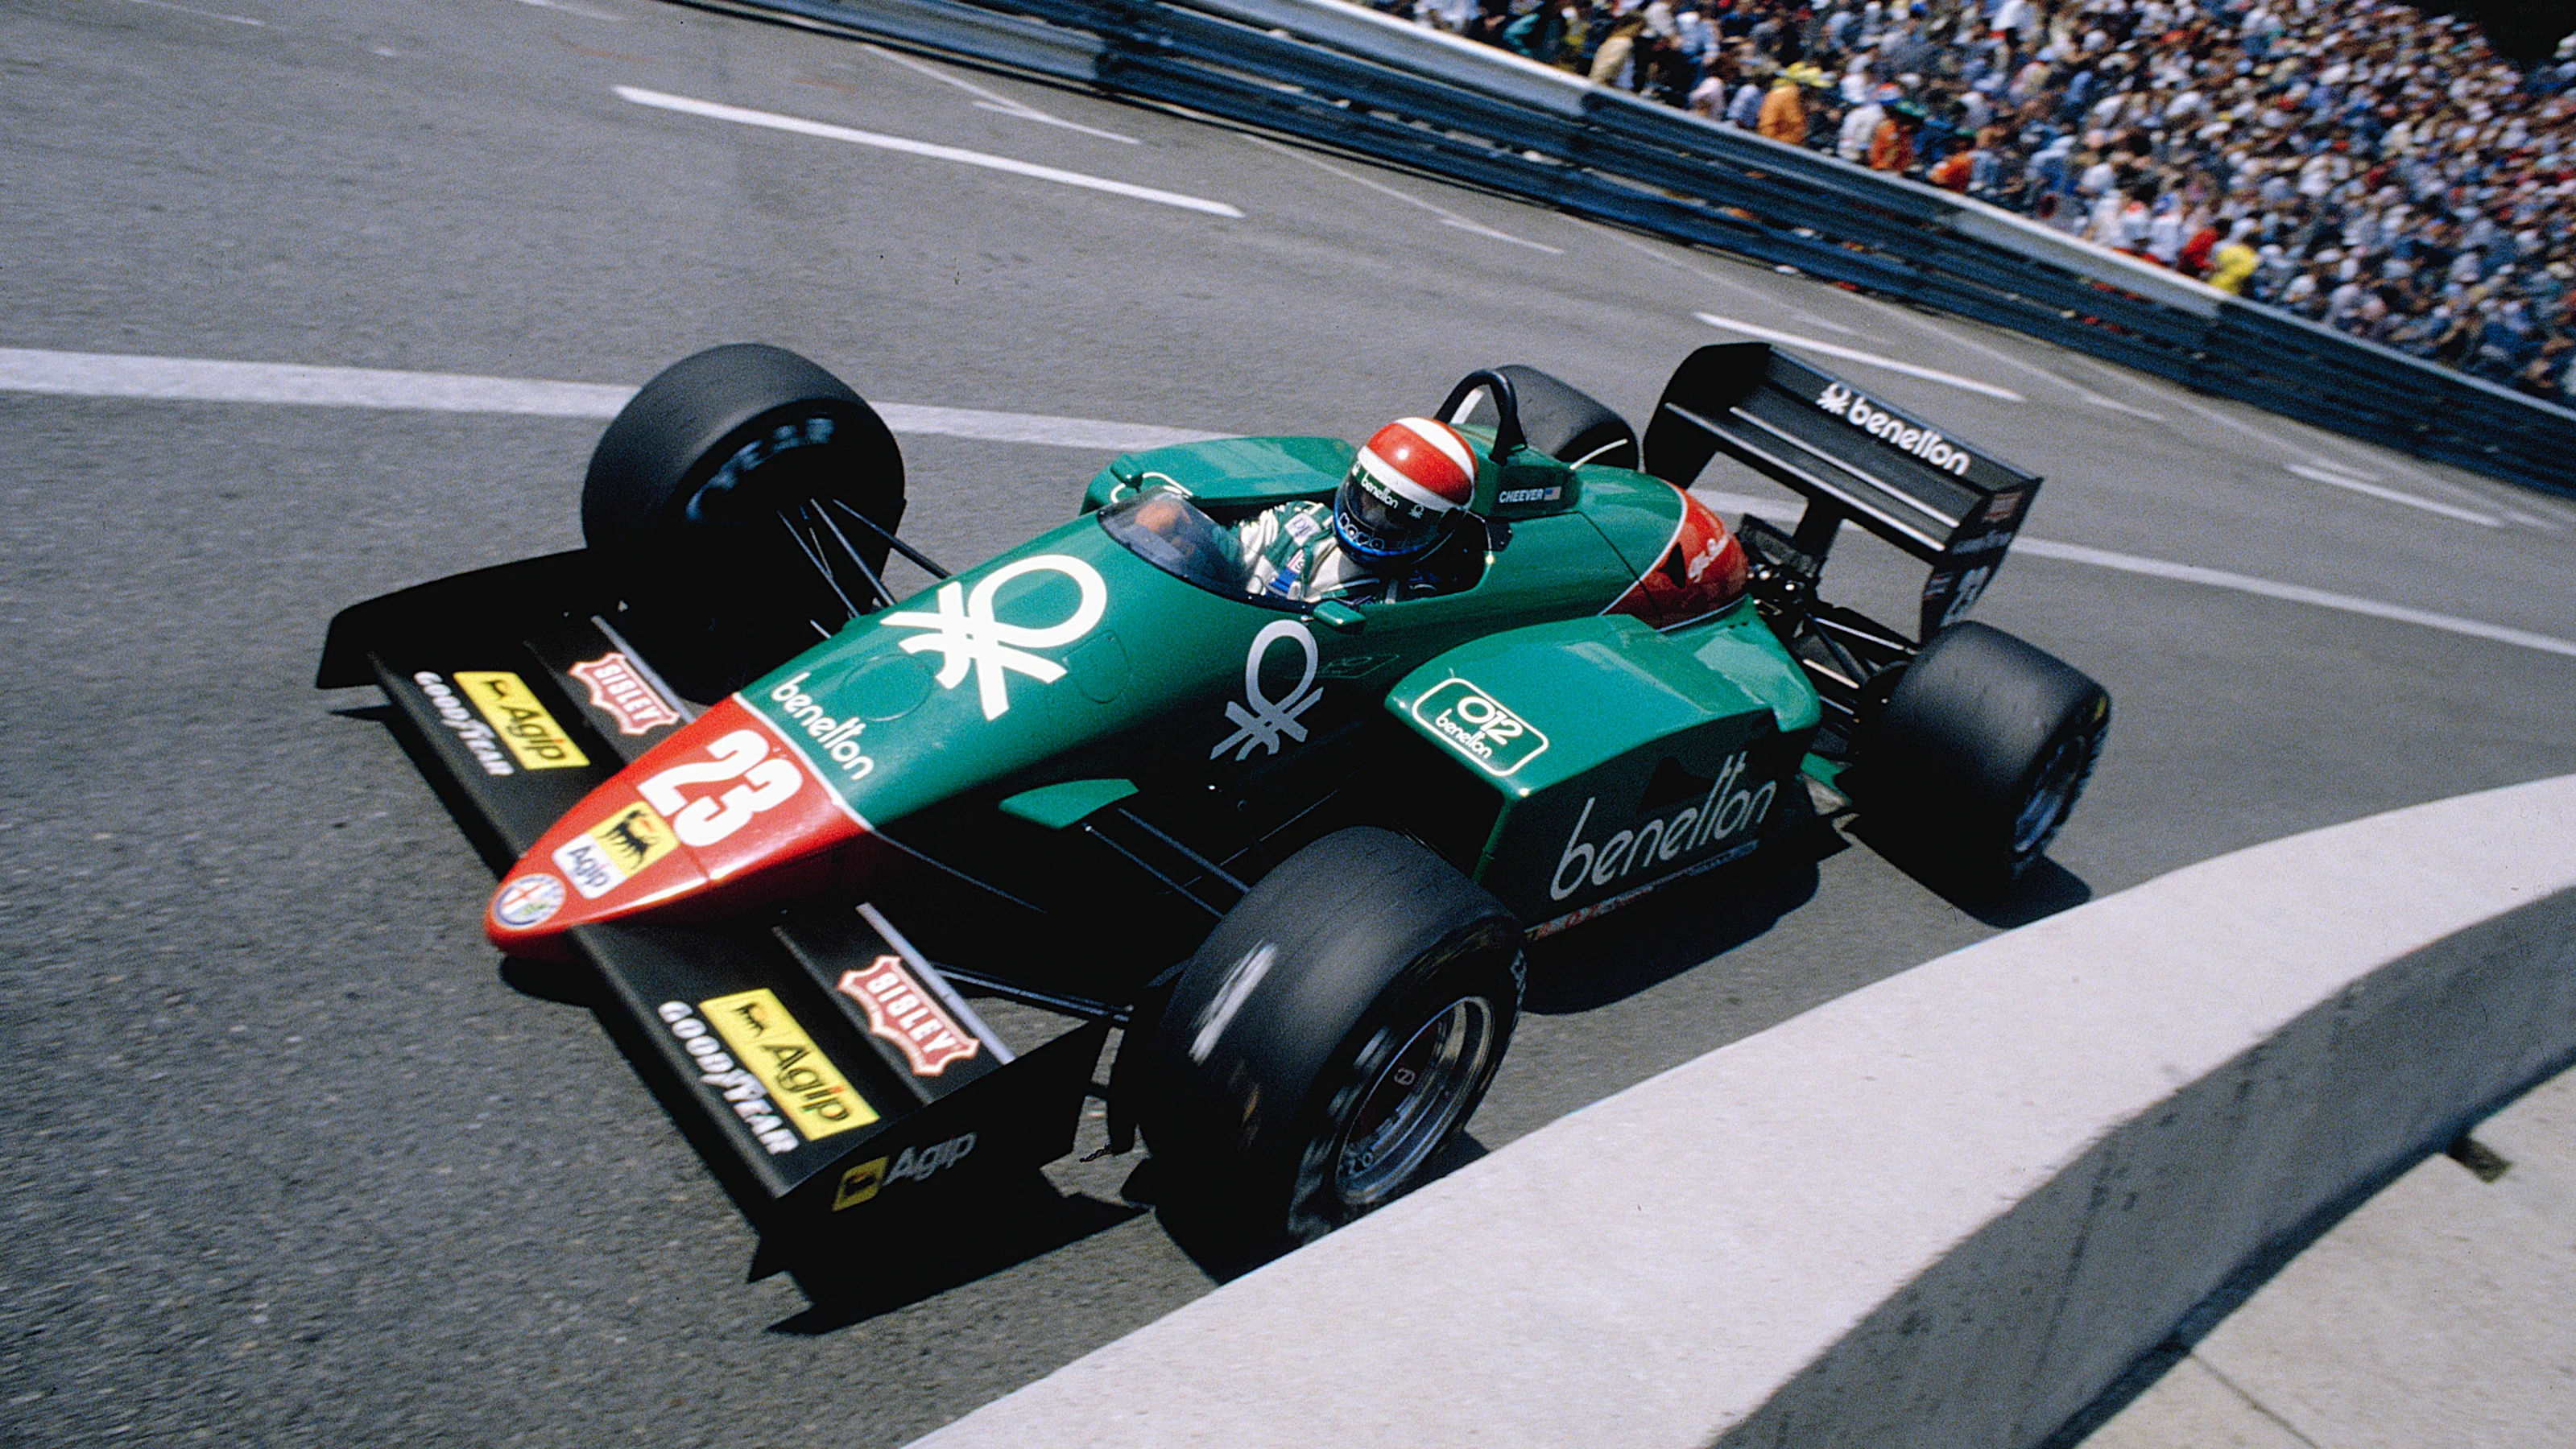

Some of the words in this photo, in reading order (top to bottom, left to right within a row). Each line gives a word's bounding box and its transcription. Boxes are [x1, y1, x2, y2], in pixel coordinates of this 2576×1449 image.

[1850, 395, 1970, 477] benetton
[1361, 473, 1399, 509] benetton
[1499, 488, 1544, 503] CHEEVER
[593, 663, 662, 721] BISLEY
[501, 705, 566, 761] Agip
[771, 672, 875, 781] benetton
[1435, 708, 1493, 760] benetton
[637, 729, 804, 847] 23
[1549, 750, 1778, 902] benetton
[566, 844, 610, 888] Agip
[865, 971, 957, 1054] BISLEY
[758, 1043, 850, 1123] Agip
[882, 1132, 978, 1182] Agip
